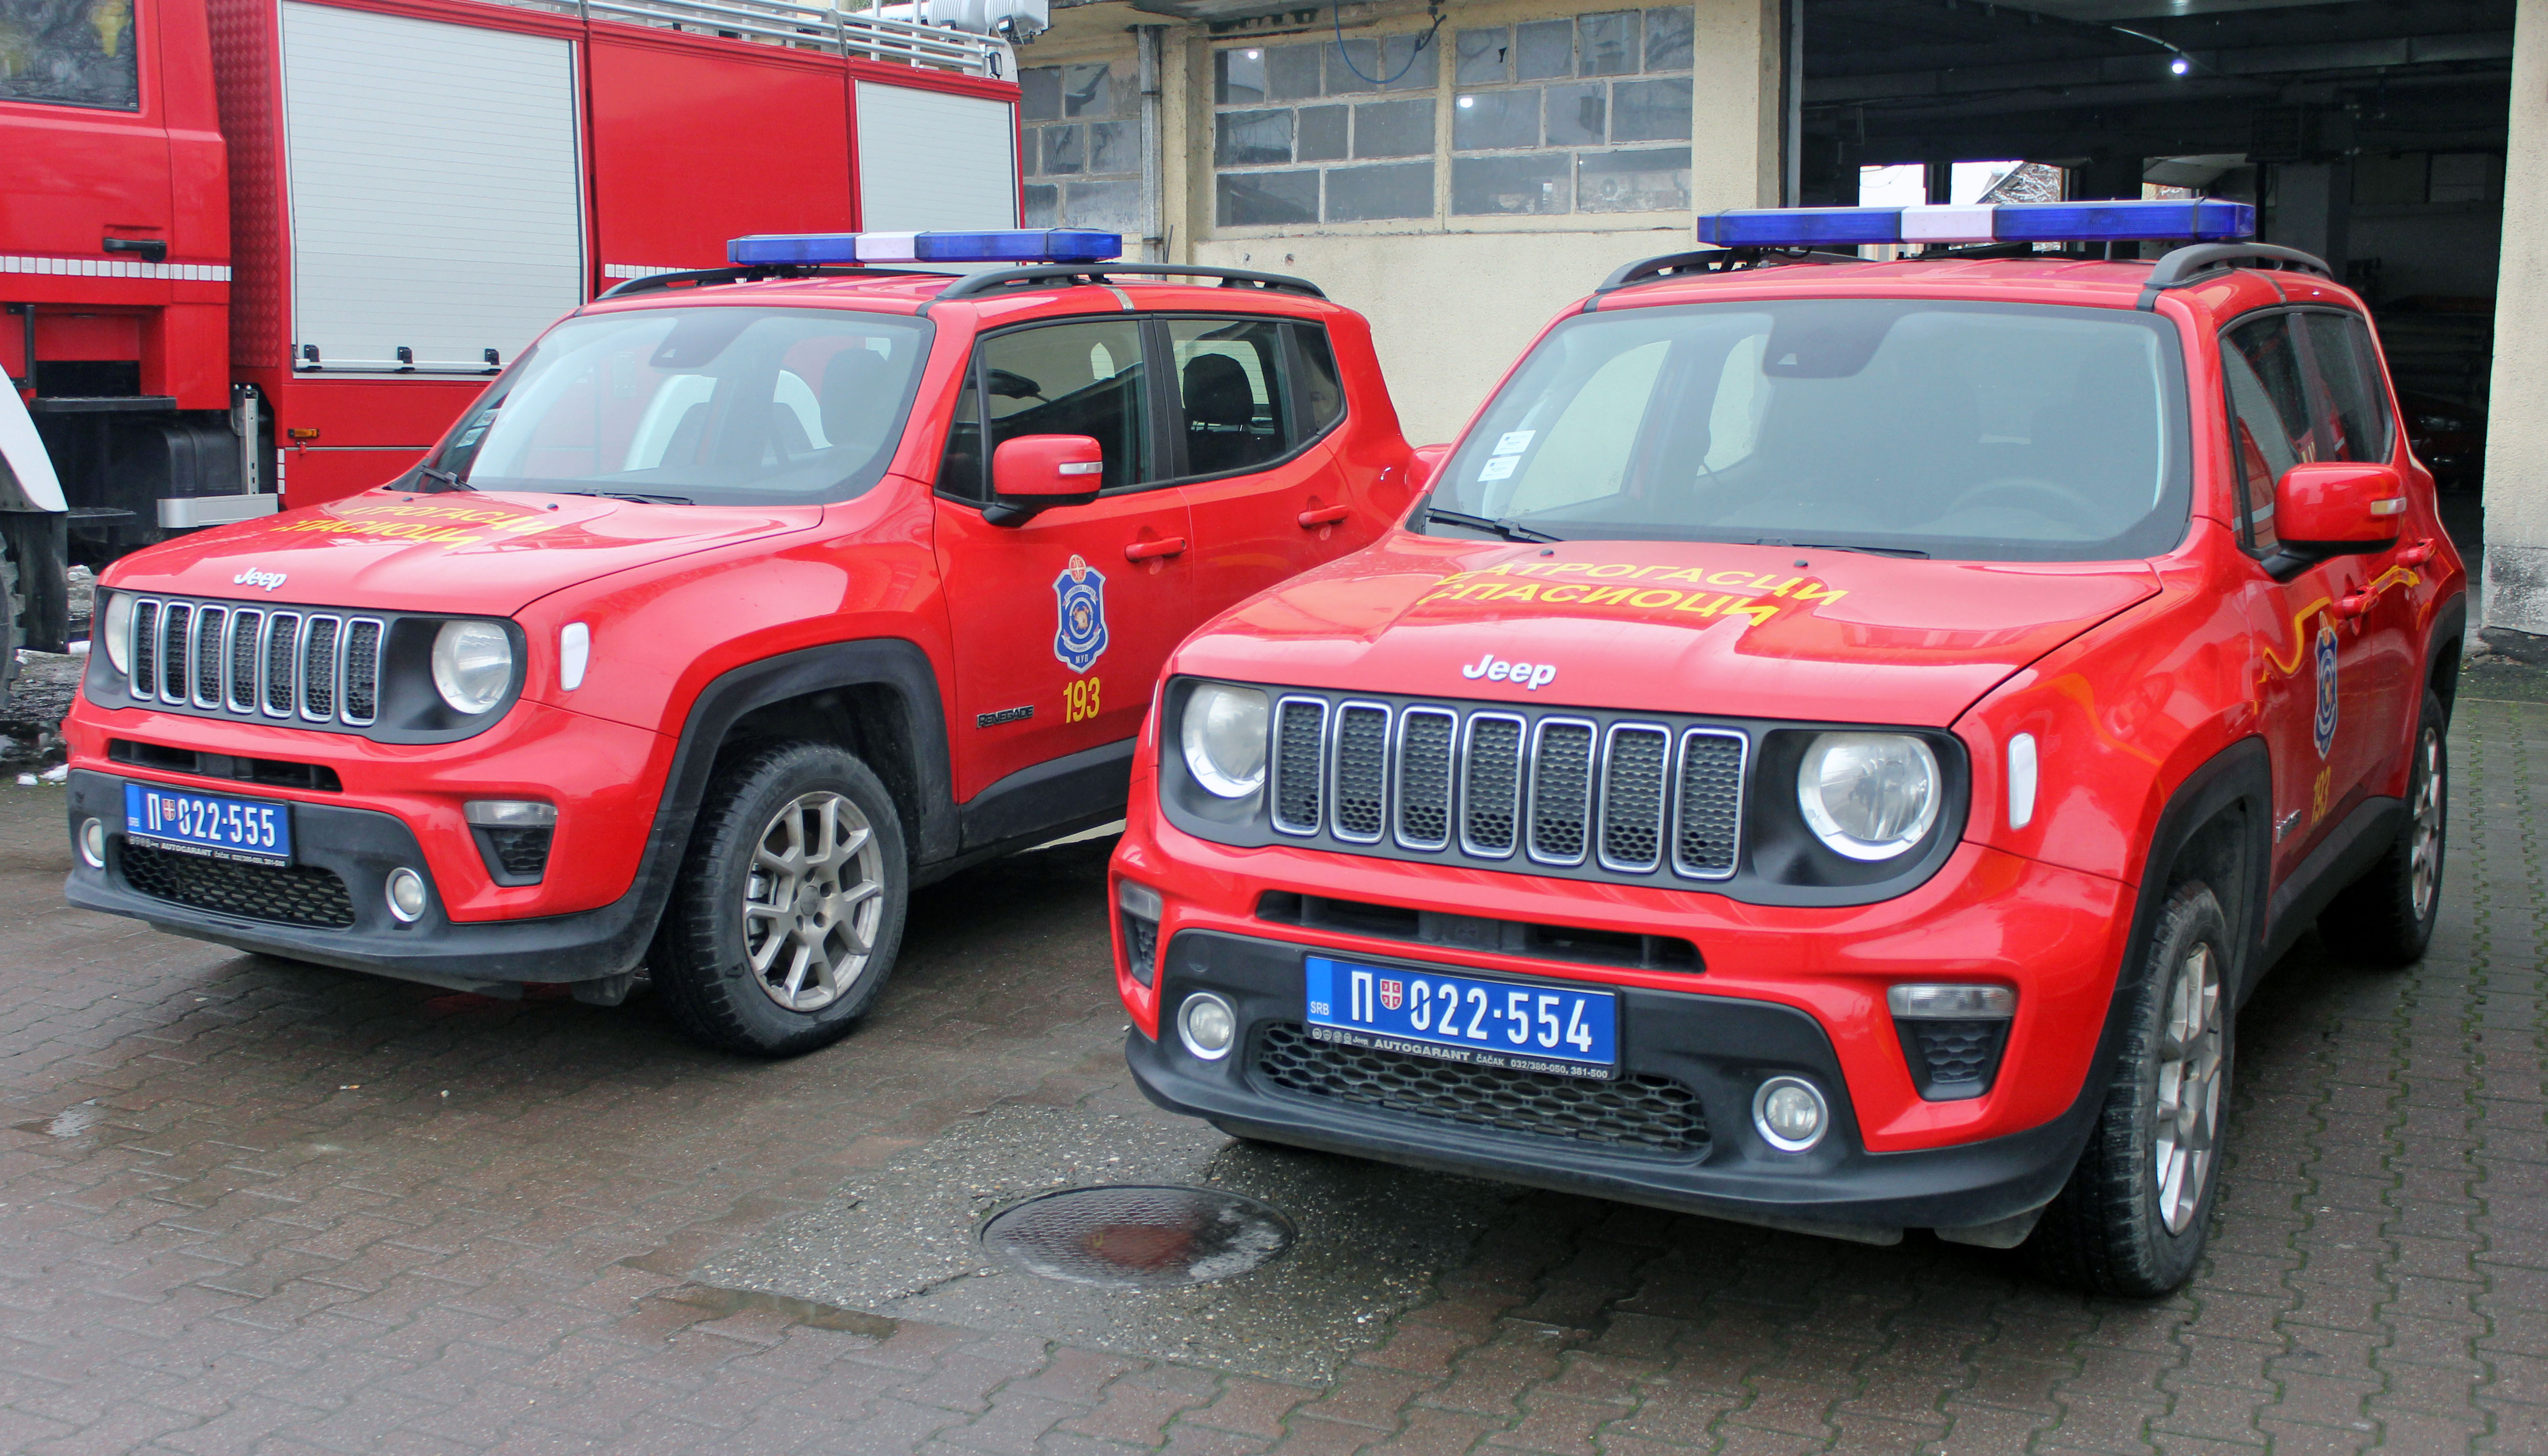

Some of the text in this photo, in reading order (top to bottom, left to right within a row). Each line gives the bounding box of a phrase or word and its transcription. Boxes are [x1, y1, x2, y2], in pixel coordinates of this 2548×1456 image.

[234, 567, 287, 592] Jeep
[1075, 654, 1088, 664] МУП
[1463, 654, 1557, 691] Jeep
[1063, 677, 1101, 723] 193
[977, 705, 1034, 729] RENEGADE
[146, 793, 162, 831] П
[160, 842, 212, 856] AUTOGARANT
[1310, 1001, 1330, 1016] SRB
[1351, 971, 1374, 1023] П
[1374, 1038, 1470, 1061] AUTOGARANT
[1476, 1053, 1505, 1066] ČAČAK
[1571, 1066, 1608, 1079] 381-500
